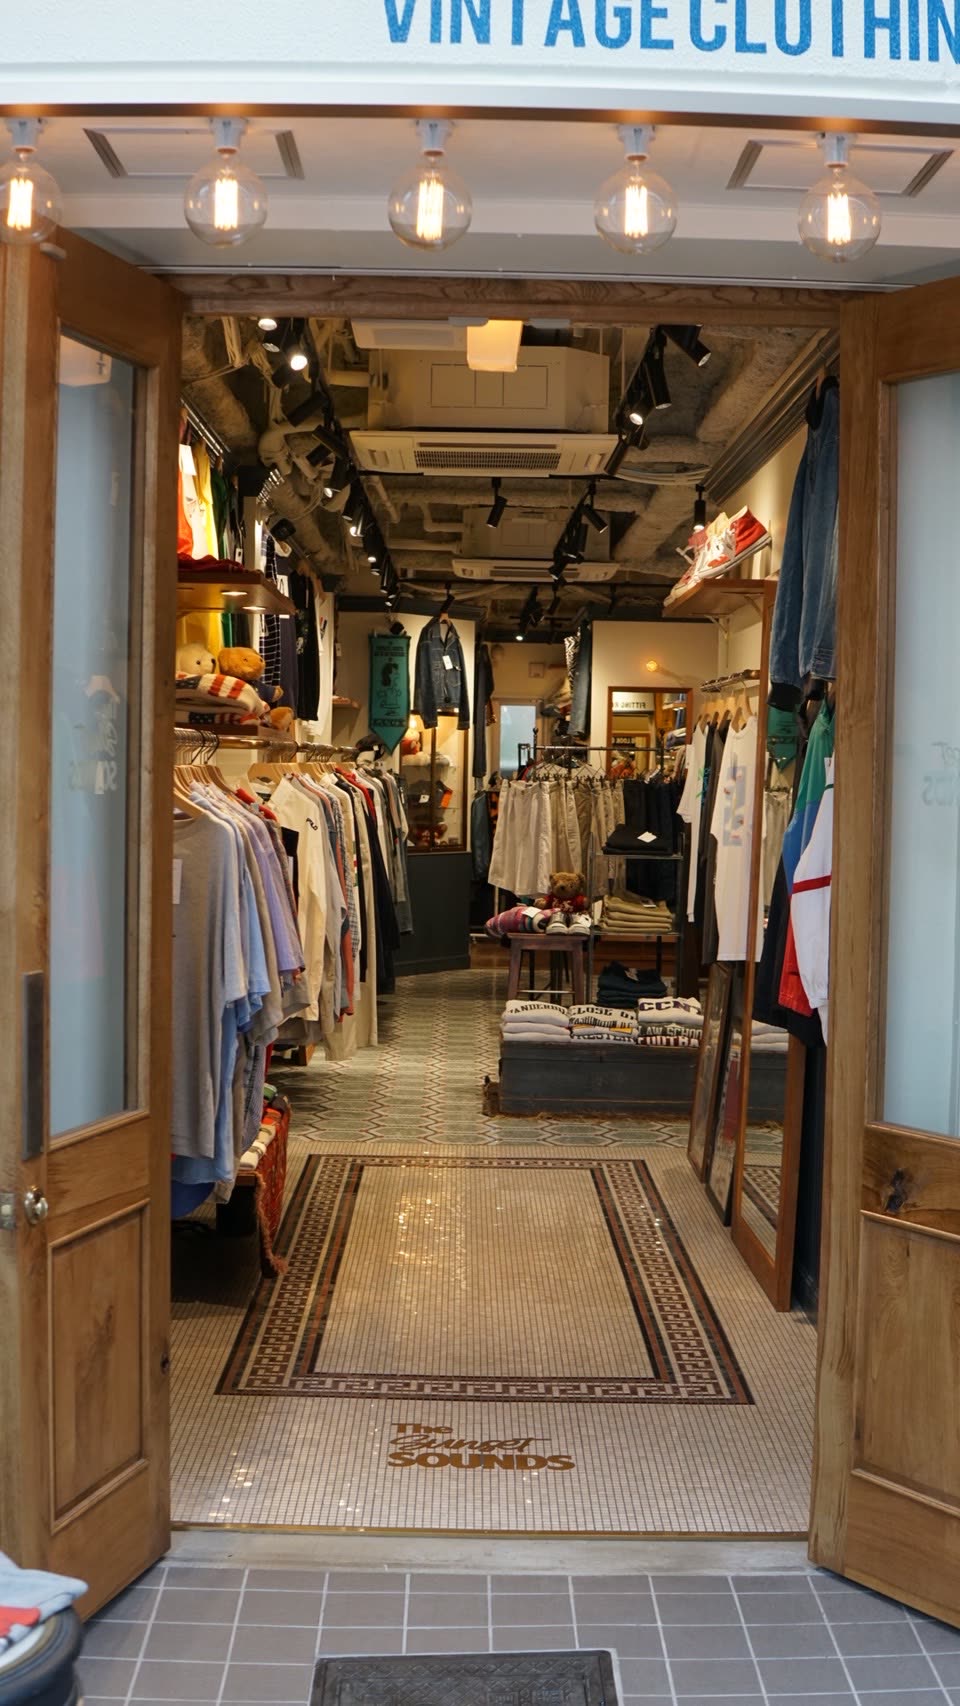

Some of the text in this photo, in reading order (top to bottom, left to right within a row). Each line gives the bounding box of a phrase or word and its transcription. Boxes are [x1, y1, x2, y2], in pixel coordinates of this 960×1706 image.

[383, 0, 674, 50] VINTAGE
[391, 1423, 453, 1434] The
[389, 1434, 551, 1453] Sunset
[387, 1452, 576, 1471] SOUNDS
